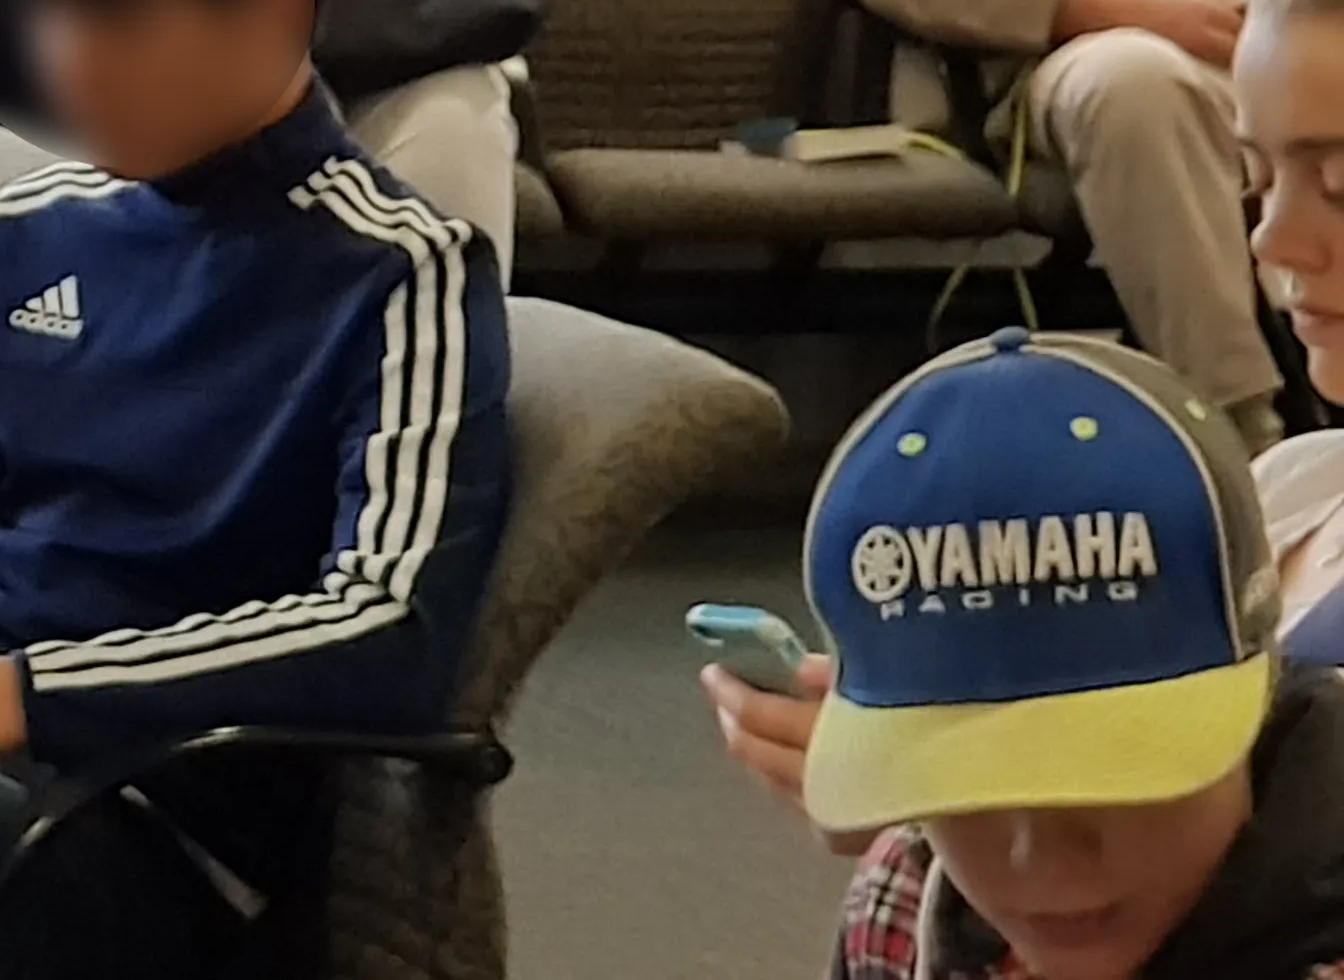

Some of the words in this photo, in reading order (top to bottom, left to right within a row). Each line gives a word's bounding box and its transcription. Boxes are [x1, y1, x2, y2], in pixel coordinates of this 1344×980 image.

[8, 308, 84, 340] adidas
[906, 511, 1158, 591] YAMAHA
[879, 581, 1139, 621] RACING
